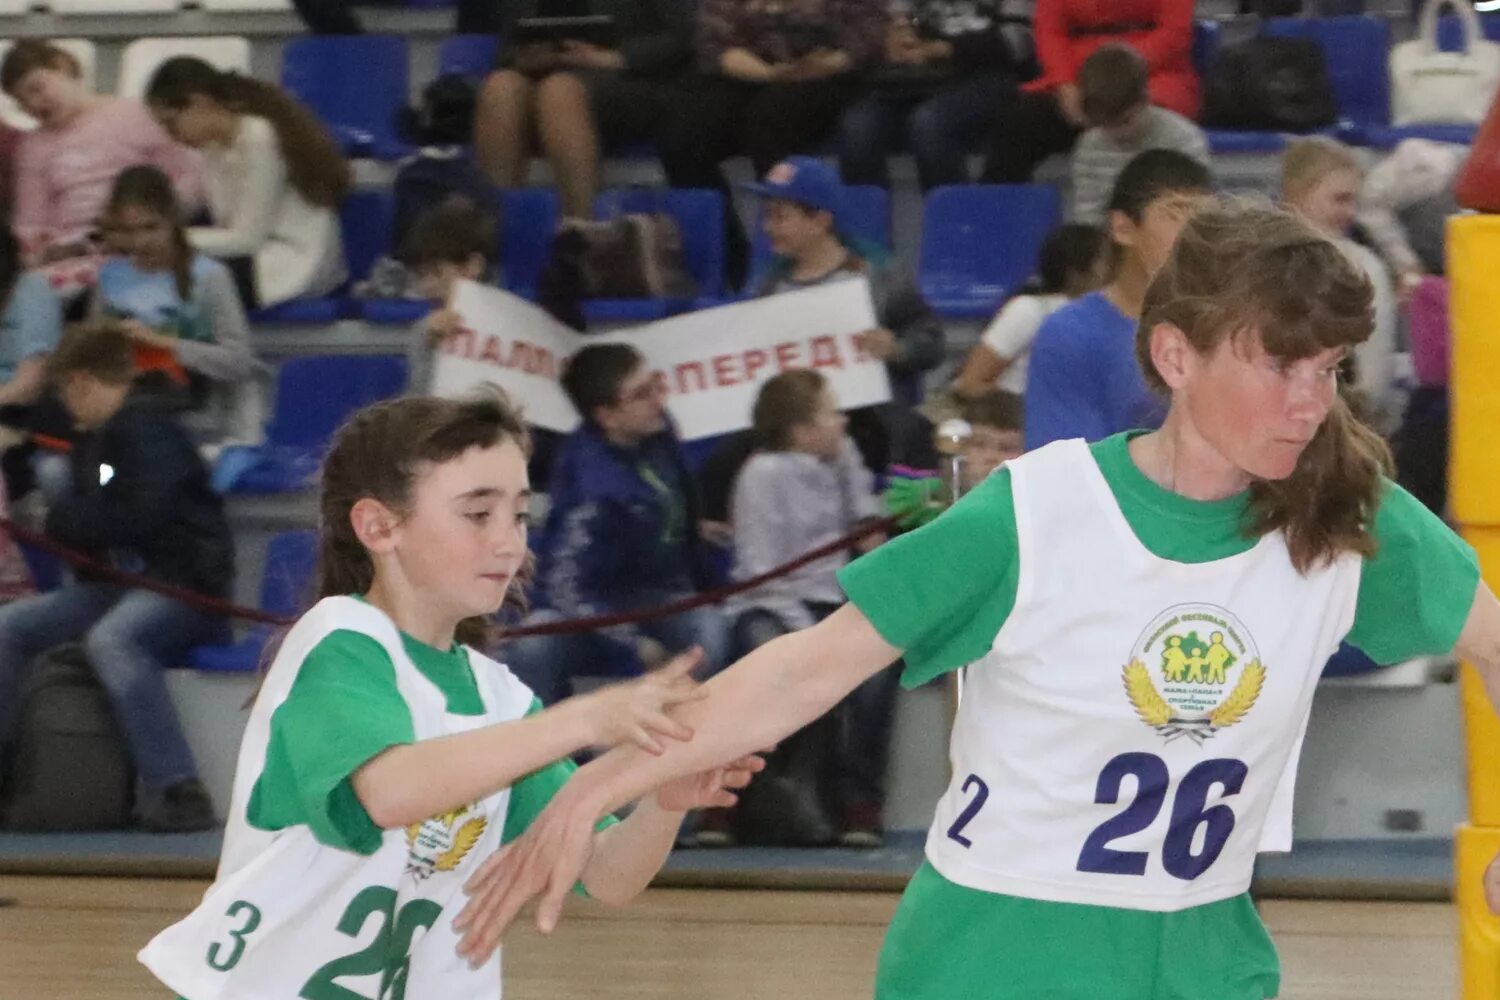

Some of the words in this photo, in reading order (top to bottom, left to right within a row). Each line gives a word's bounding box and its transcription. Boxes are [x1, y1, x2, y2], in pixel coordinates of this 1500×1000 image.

[947, 773, 989, 849] 2
[1076, 752, 1248, 880] 26
[206, 900, 261, 972] 3
